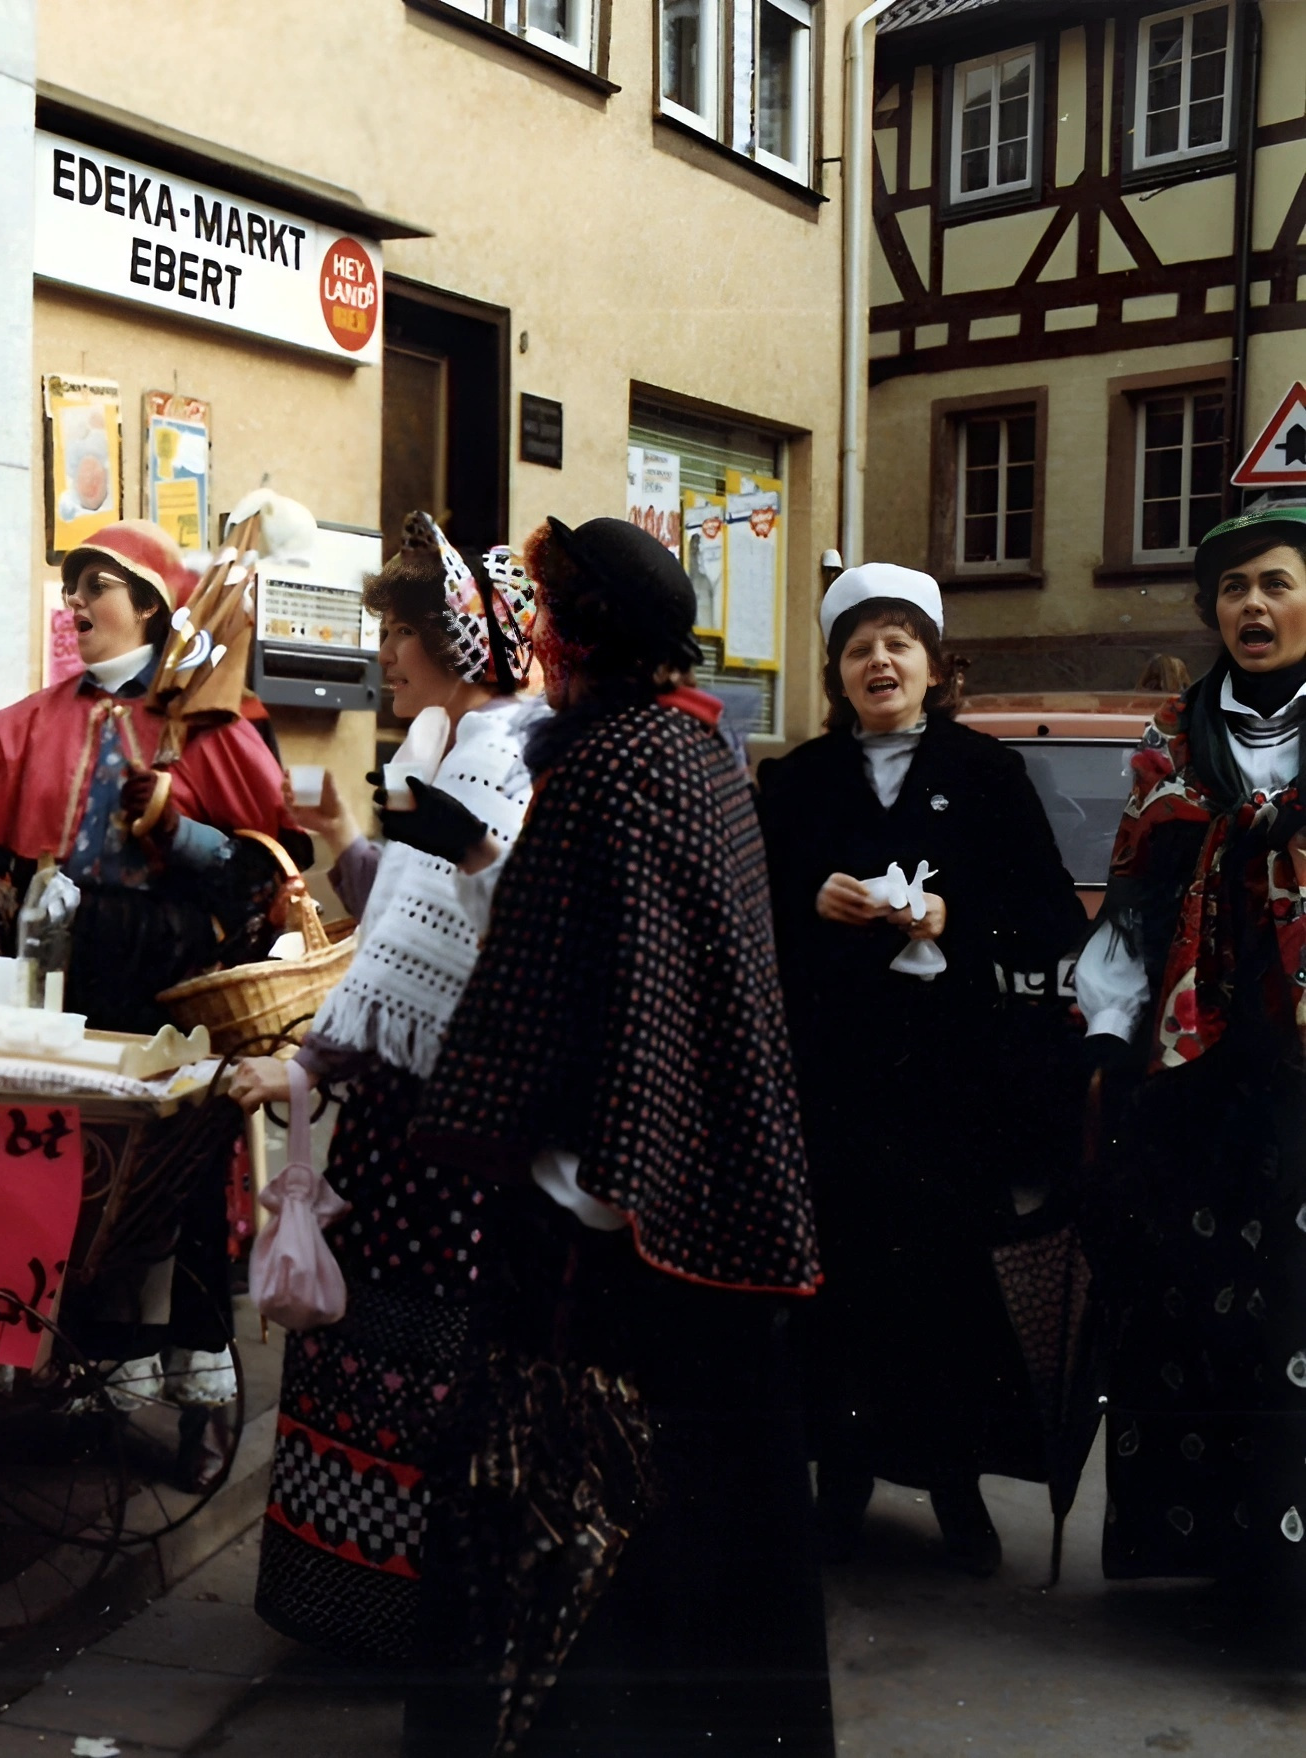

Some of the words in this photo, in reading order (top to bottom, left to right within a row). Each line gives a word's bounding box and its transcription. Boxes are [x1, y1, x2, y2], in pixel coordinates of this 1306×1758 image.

[52, 147, 306, 271] EDEKA-MARKT
[130, 236, 243, 310] EBERT
[324, 276, 375, 309] LANDS
[333, 253, 366, 283] HEY
